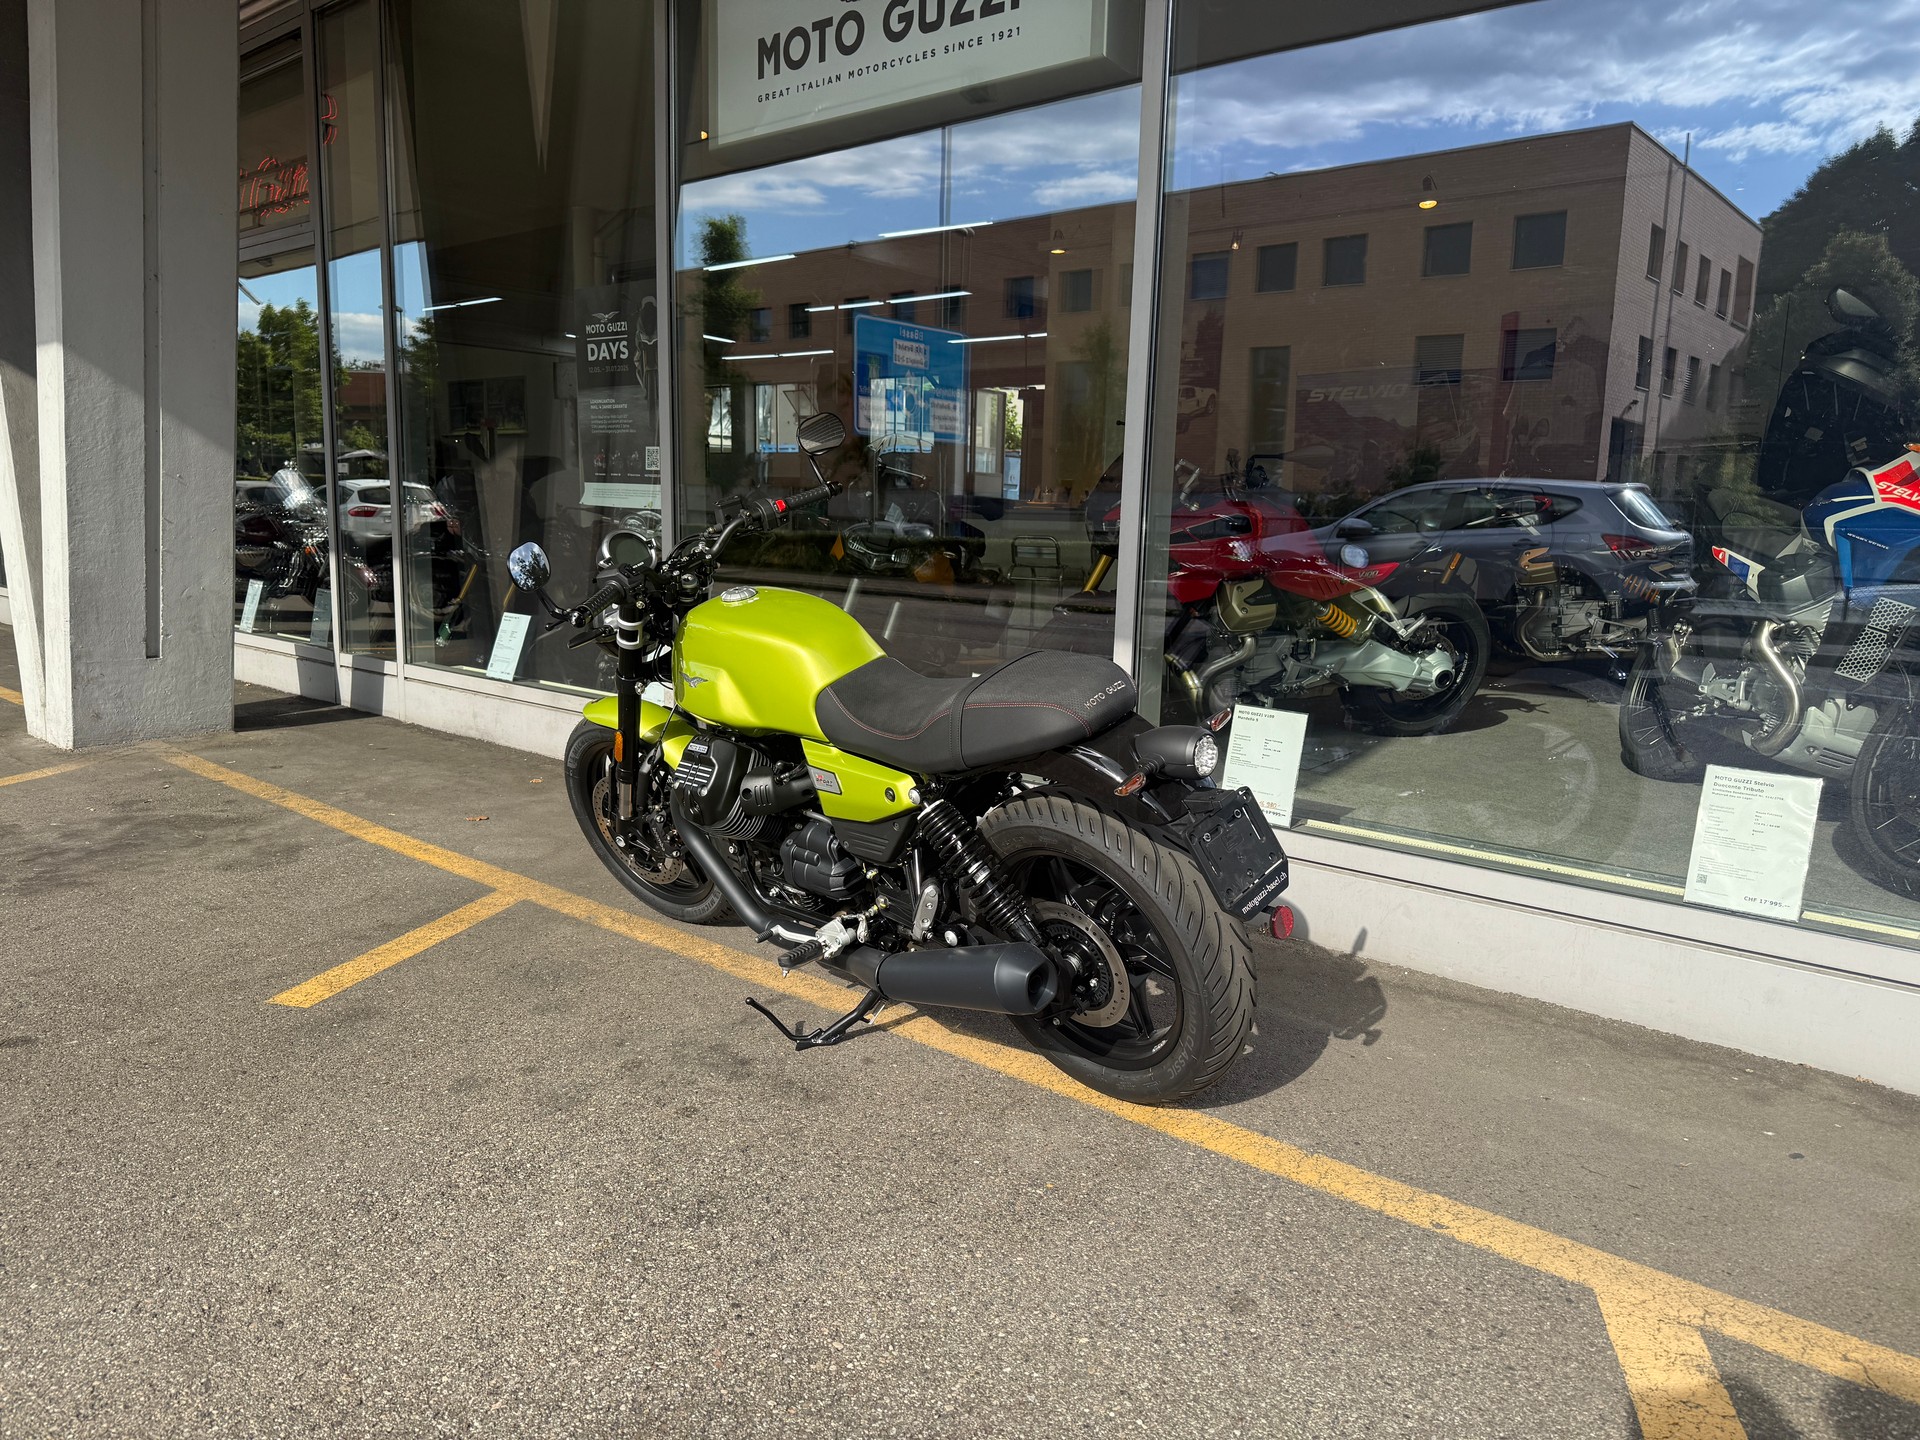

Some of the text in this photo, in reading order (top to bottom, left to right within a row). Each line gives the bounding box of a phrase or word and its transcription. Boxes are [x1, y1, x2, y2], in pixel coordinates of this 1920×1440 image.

[757, 0, 1020, 80] MOTO GUZ
[757, 26, 1021, 103] GREAT ITALIAN MOTORCYCLES SINCE 1921
[585, 321, 628, 334] MOTO GUZZI
[587, 340, 629, 362] DAYS
[1306, 383, 1409, 404] STELVIO
[1083, 680, 1126, 710] MOTO GUZZI
[1714, 775, 1775, 788] MOTO GUZZI Stelvio
[1743, 785, 1765, 793] Tributo
[1241, 871, 1288, 915] motoguzzi-basel.ch
[1743, 895, 1757, 903] CHF
[1167, 1035, 1195, 1080] CLASSIC
